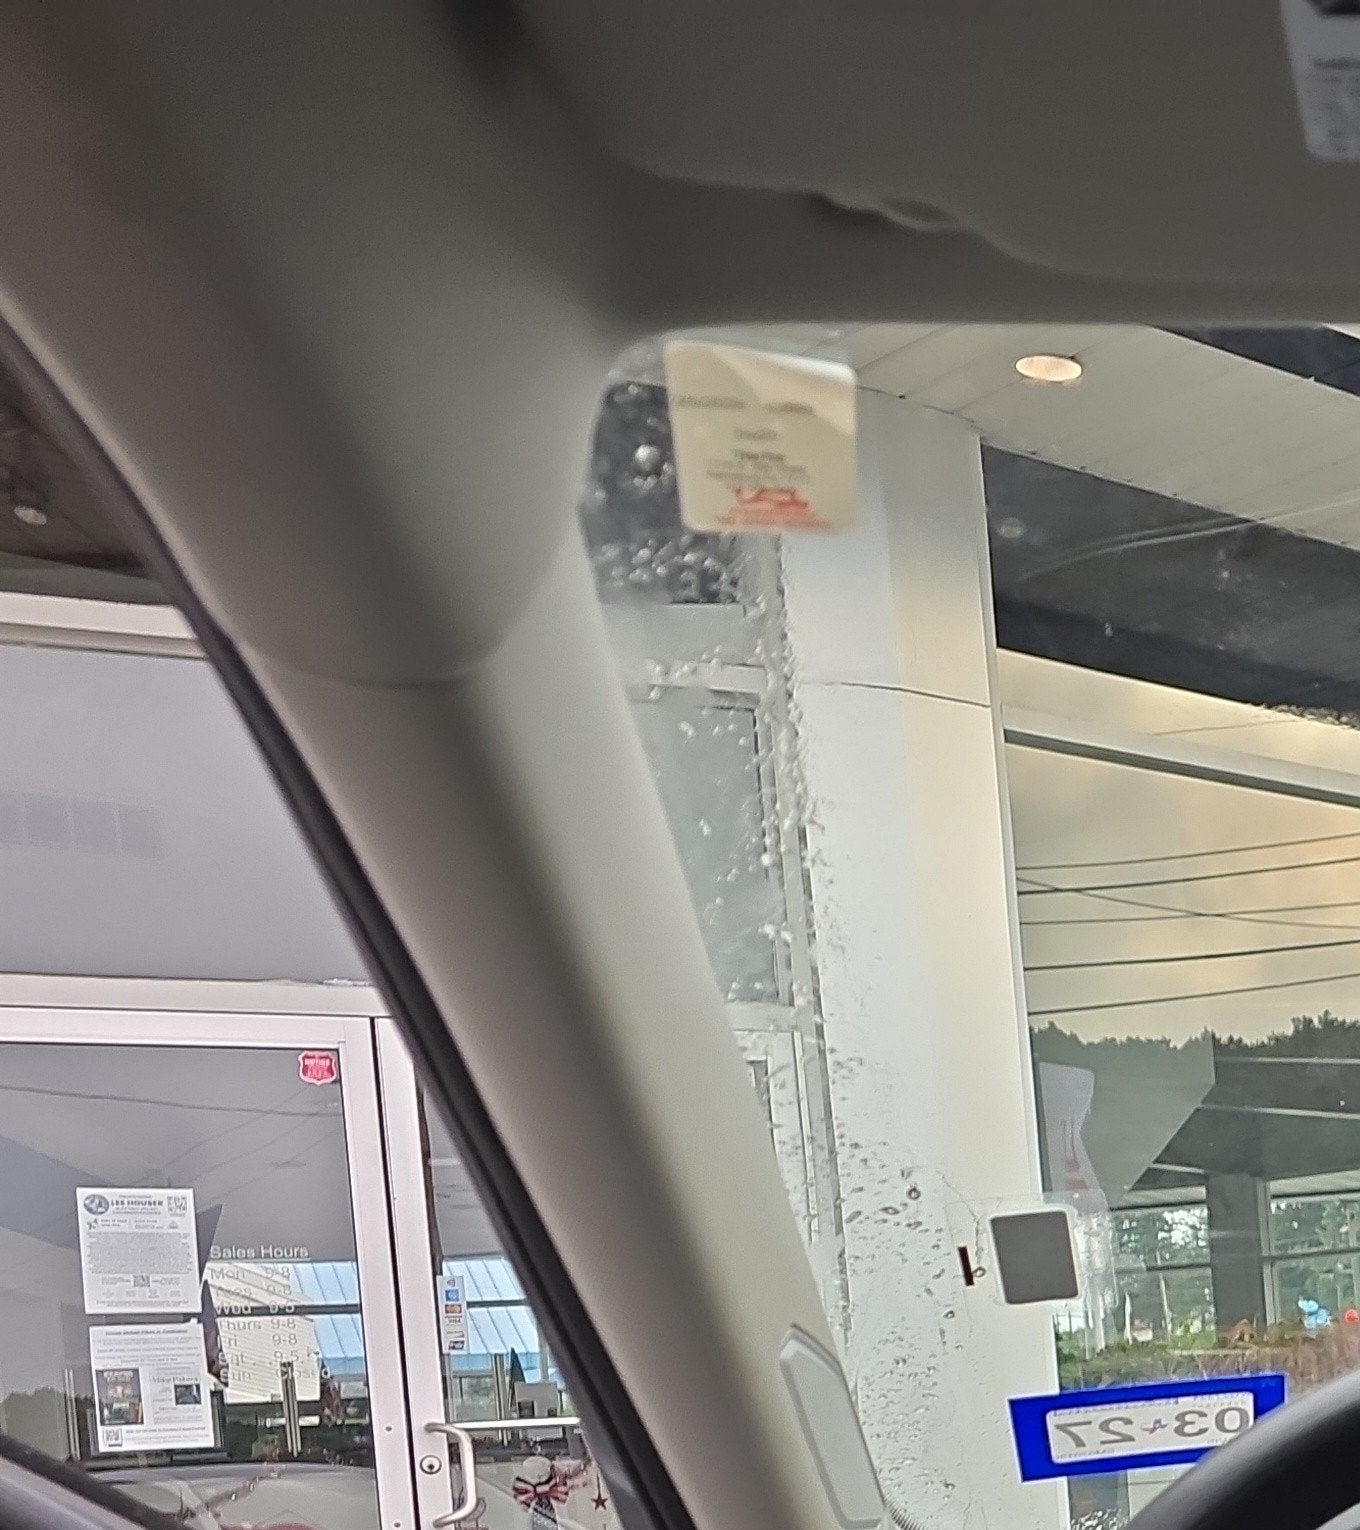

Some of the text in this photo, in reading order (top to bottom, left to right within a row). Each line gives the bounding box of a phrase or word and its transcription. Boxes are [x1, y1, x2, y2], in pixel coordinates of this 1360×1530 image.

[210, 1244, 309, 1258] Sales Hours
[271, 1317, 296, 1330] 9-8
[271, 1333, 298, 1346] 9-8
